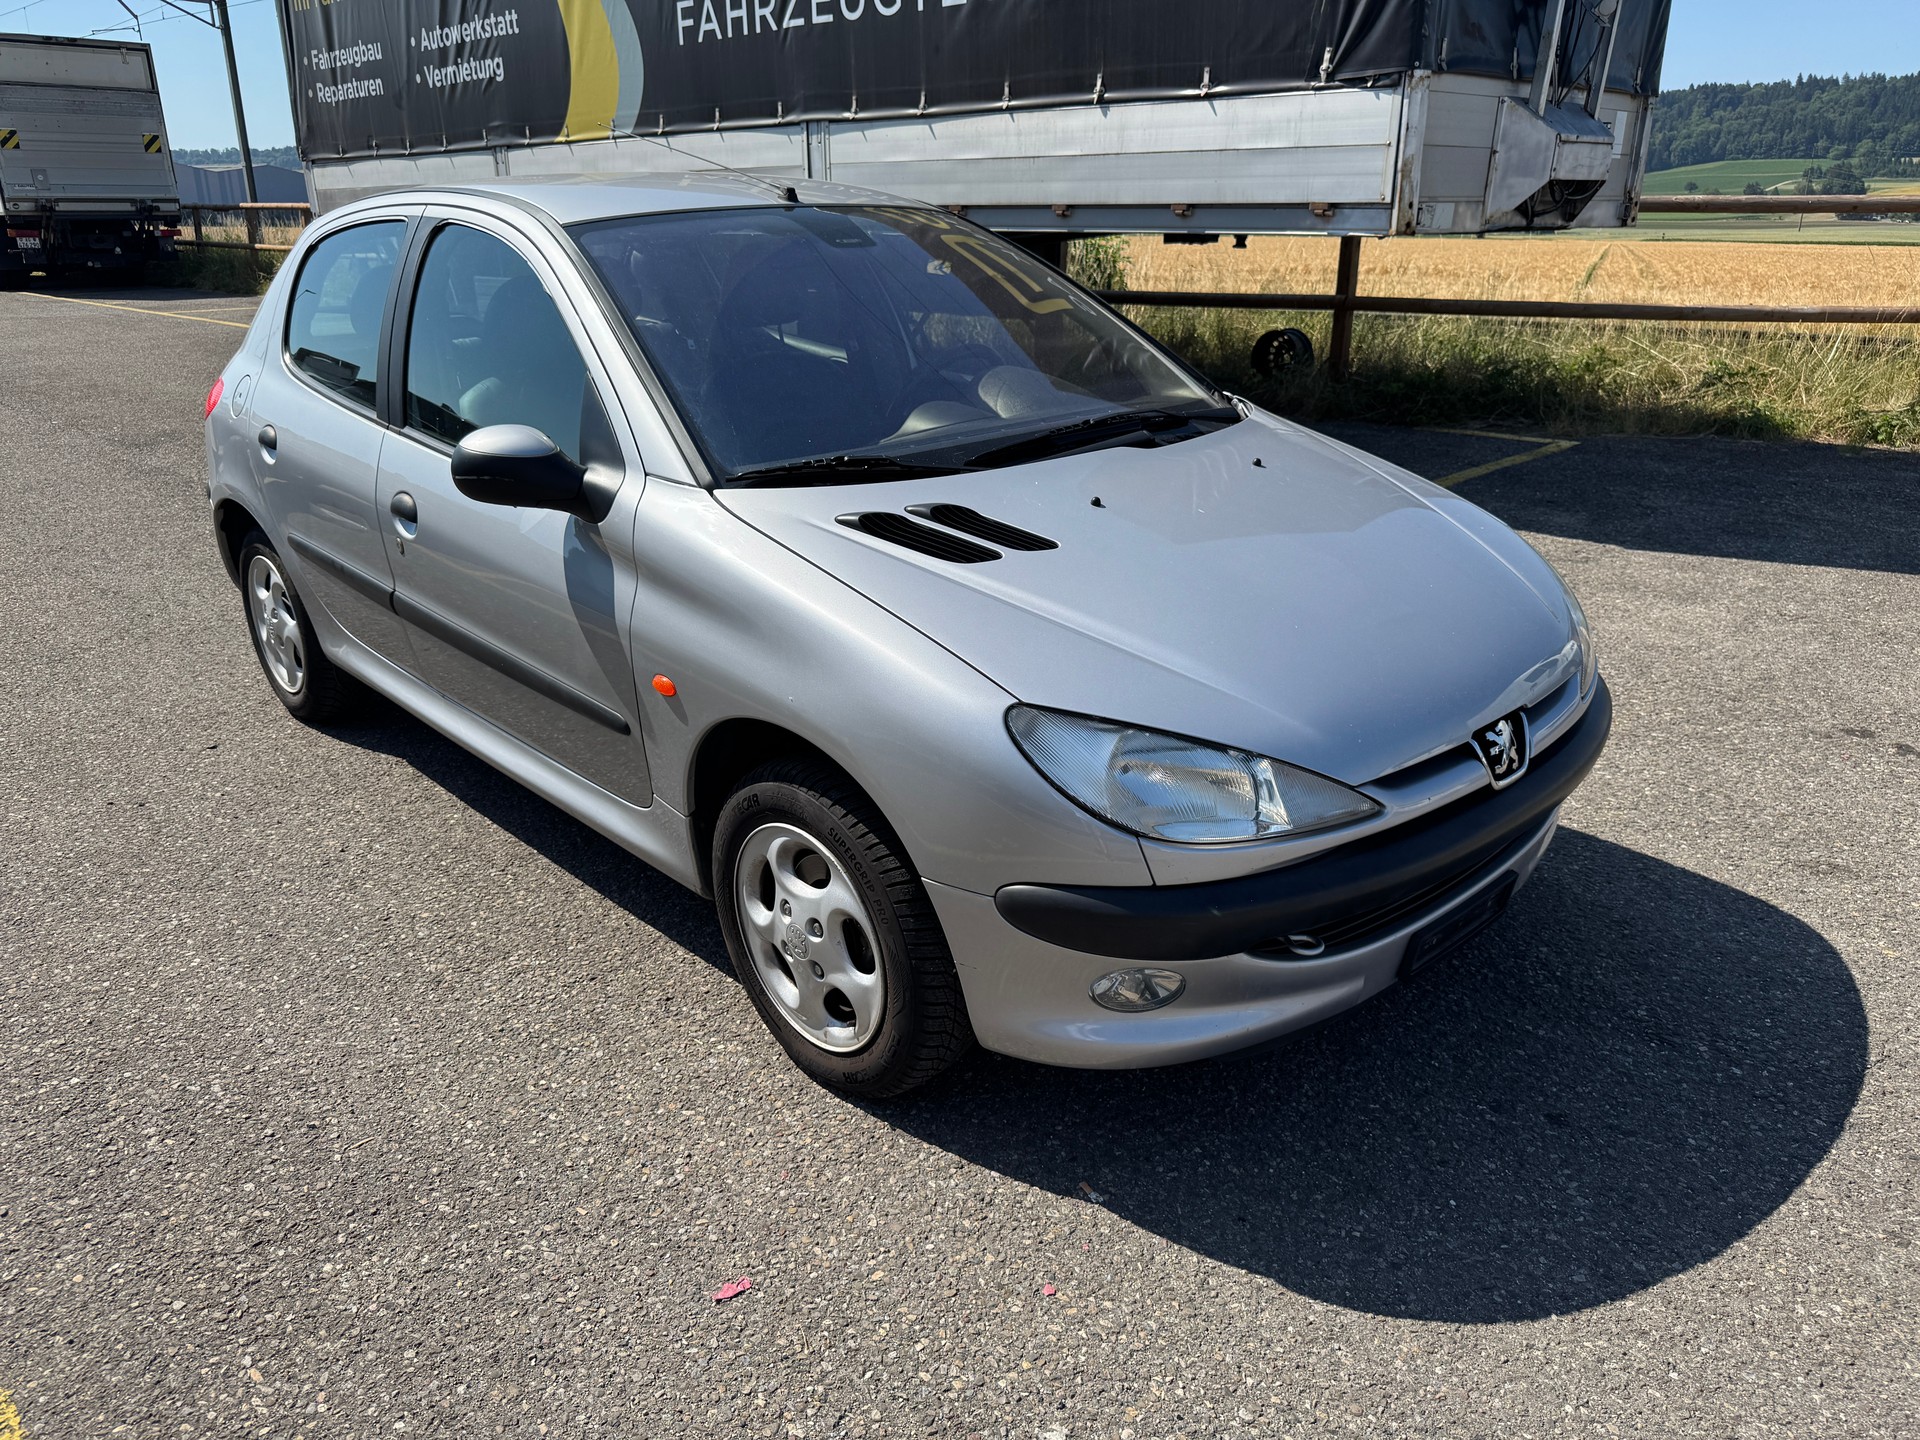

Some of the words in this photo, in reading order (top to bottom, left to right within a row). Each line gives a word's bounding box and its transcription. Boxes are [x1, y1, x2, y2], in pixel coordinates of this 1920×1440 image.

[421, 9, 519, 51] Autowerkstatt
[677, 0, 967, 46] FAHRZE
[311, 40, 382, 71] Fahrzeugbau
[424, 55, 504, 89] Vermietung
[316, 77, 384, 106] Reparaturen
[827, 827, 875, 893] SUPERGRIP
[873, 899, 889, 925] PRO
